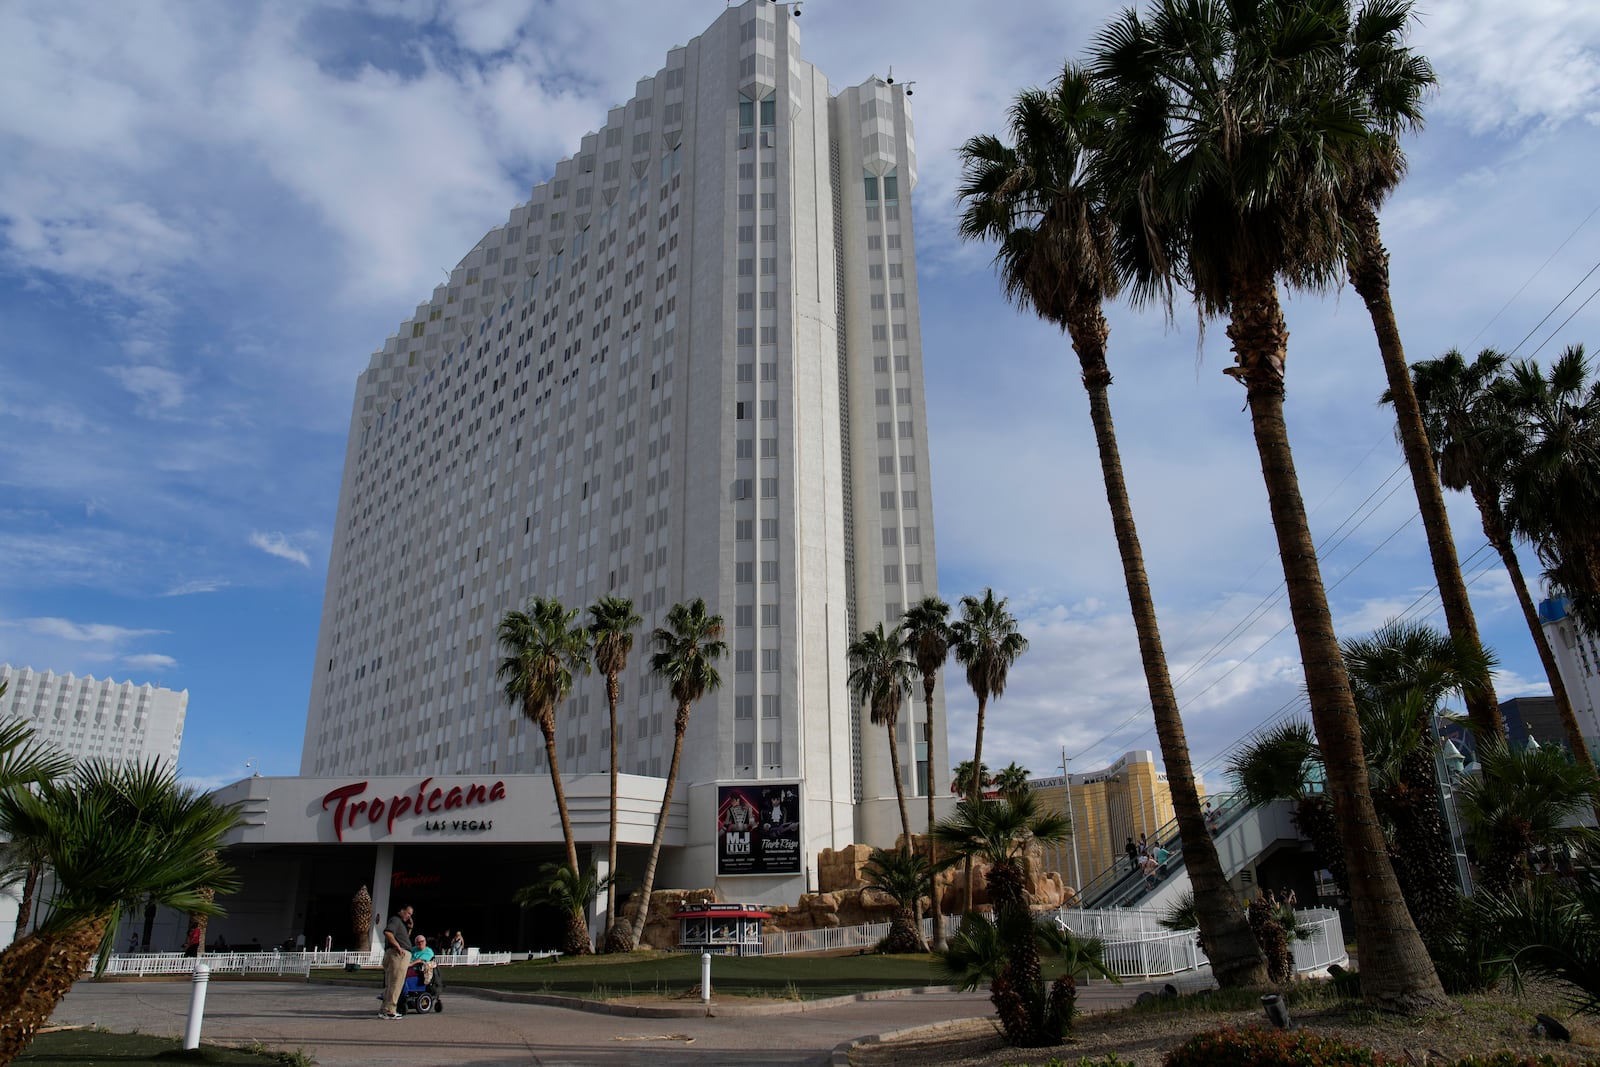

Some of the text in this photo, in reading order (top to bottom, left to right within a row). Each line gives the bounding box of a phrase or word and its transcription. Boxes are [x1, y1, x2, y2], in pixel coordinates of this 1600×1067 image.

[322, 776, 507, 843] Tropicana
[426, 820, 493, 831] LAS VEGAS
[726, 832, 750, 844] MJ
[727, 843, 750, 853] LIVE
